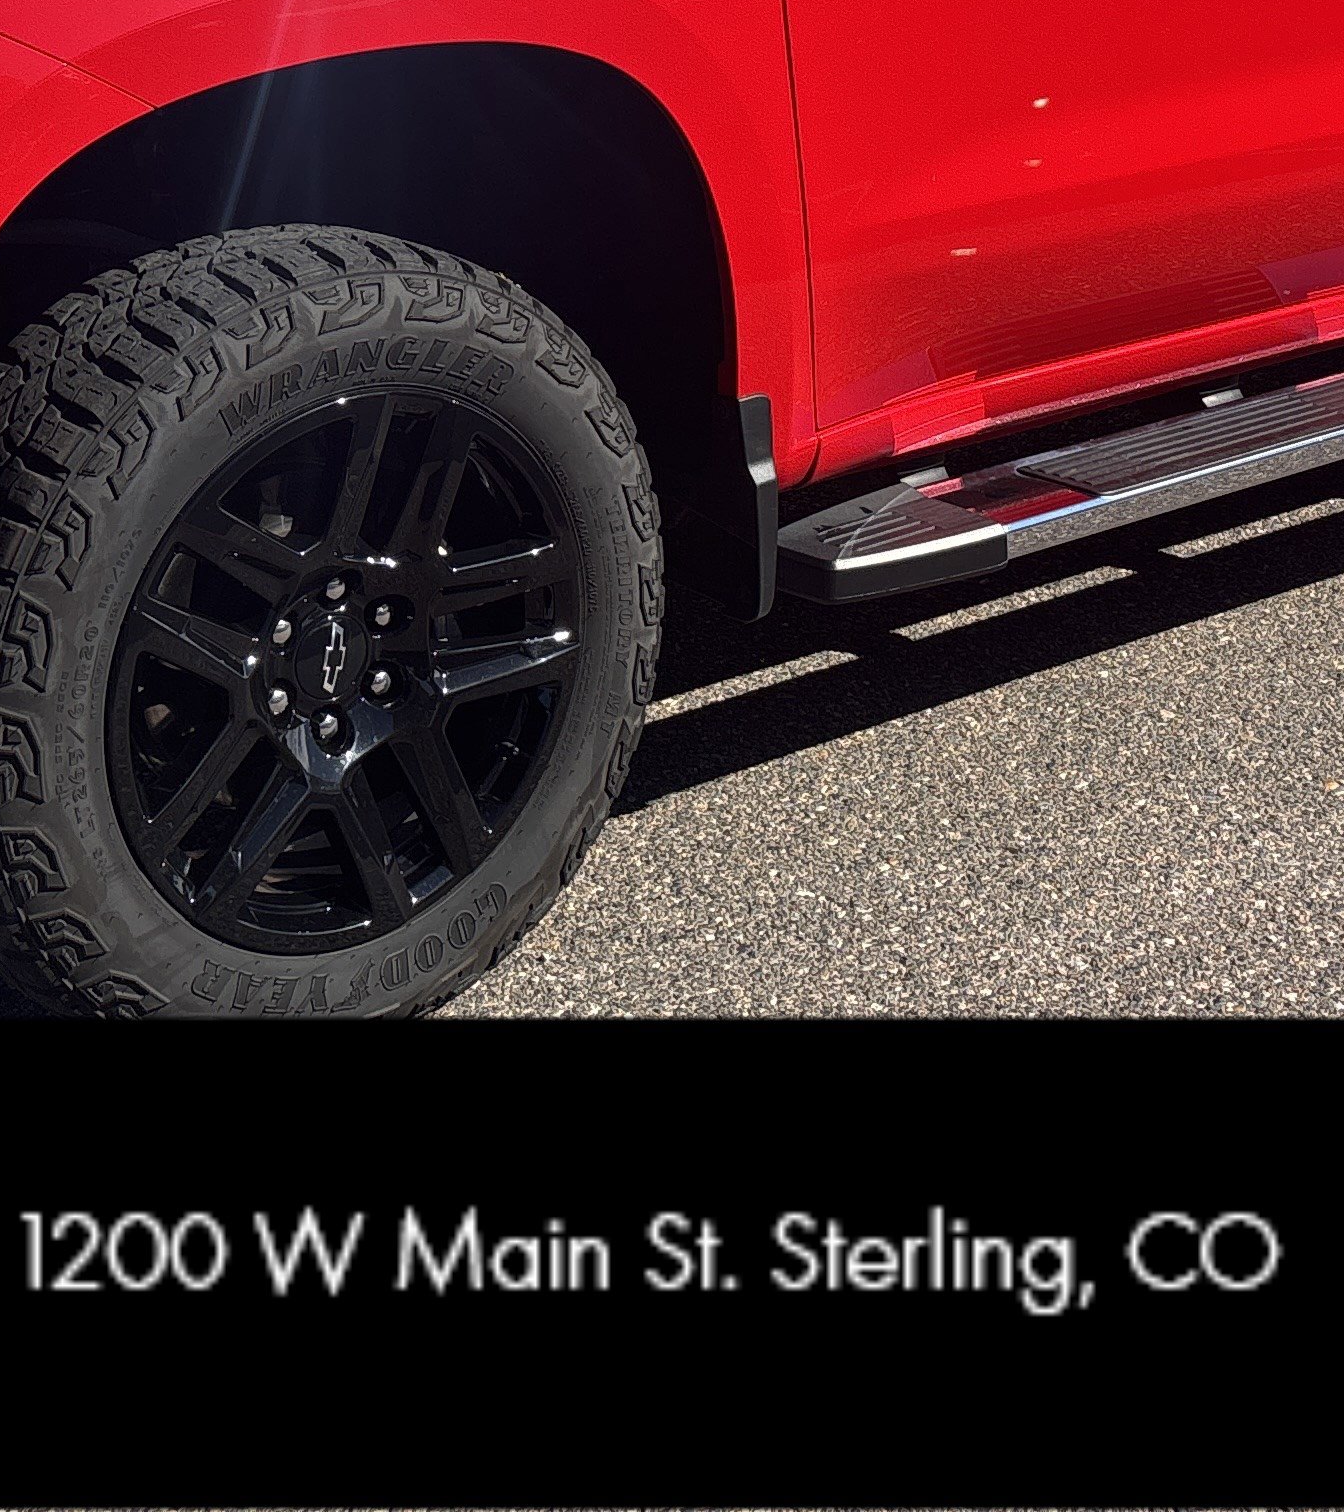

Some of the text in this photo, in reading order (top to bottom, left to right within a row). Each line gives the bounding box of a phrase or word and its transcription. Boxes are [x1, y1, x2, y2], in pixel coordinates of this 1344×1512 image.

[217, 334, 516, 436] WRANGLER
[600, 499, 634, 738] TERRITORY MT
[190, 882, 508, 1017] GOODYEAR
